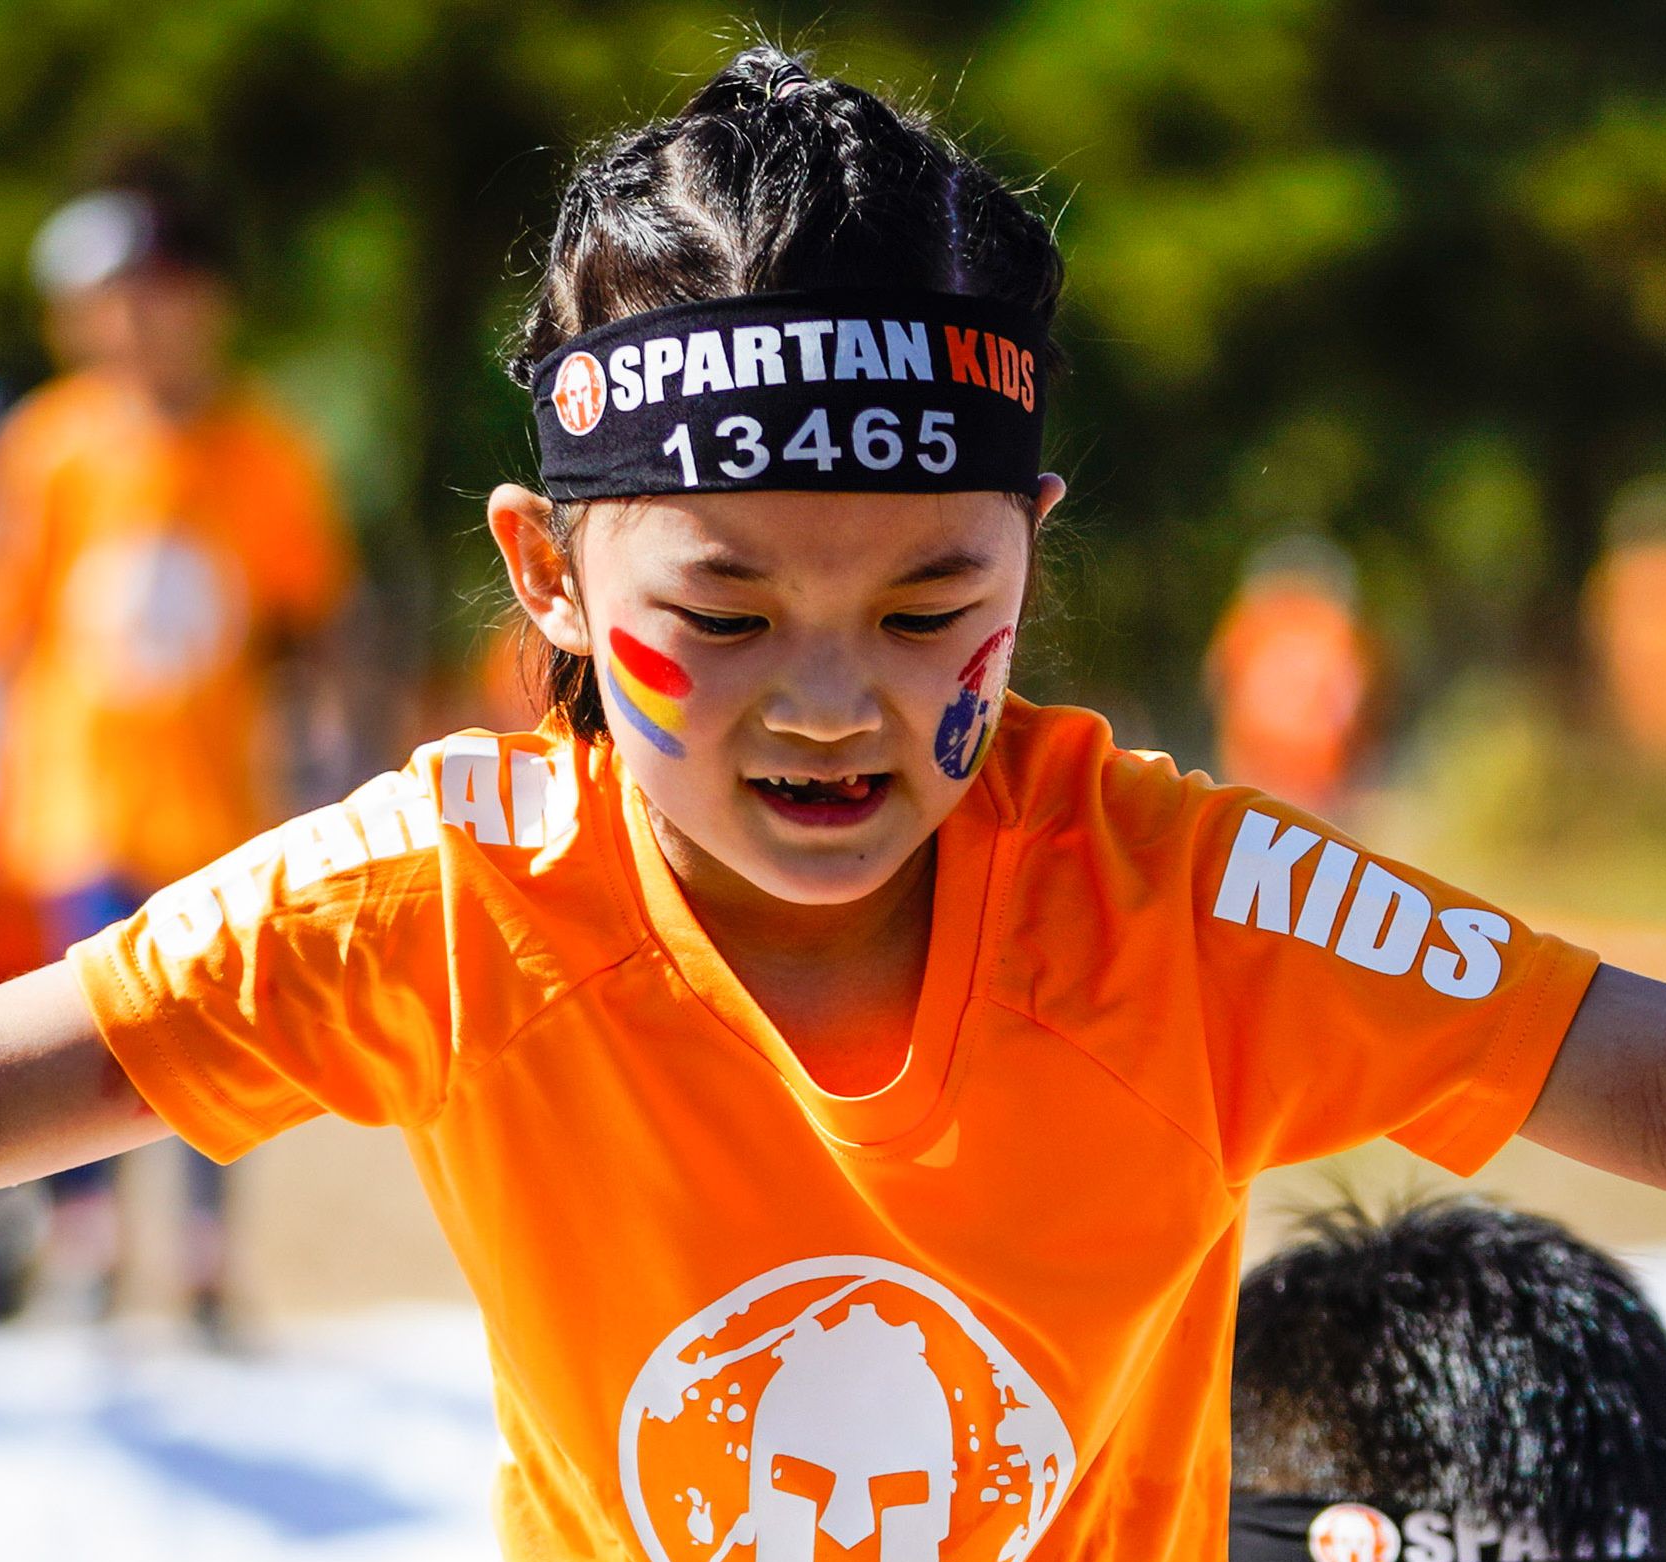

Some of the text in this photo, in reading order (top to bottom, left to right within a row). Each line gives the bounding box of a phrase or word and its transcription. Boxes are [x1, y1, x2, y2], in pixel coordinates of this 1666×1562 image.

[608, 319, 1035, 414] SPARTAN KIDS
[662, 407, 958, 487] 13465
[1212, 808, 1512, 1000] KIDS
